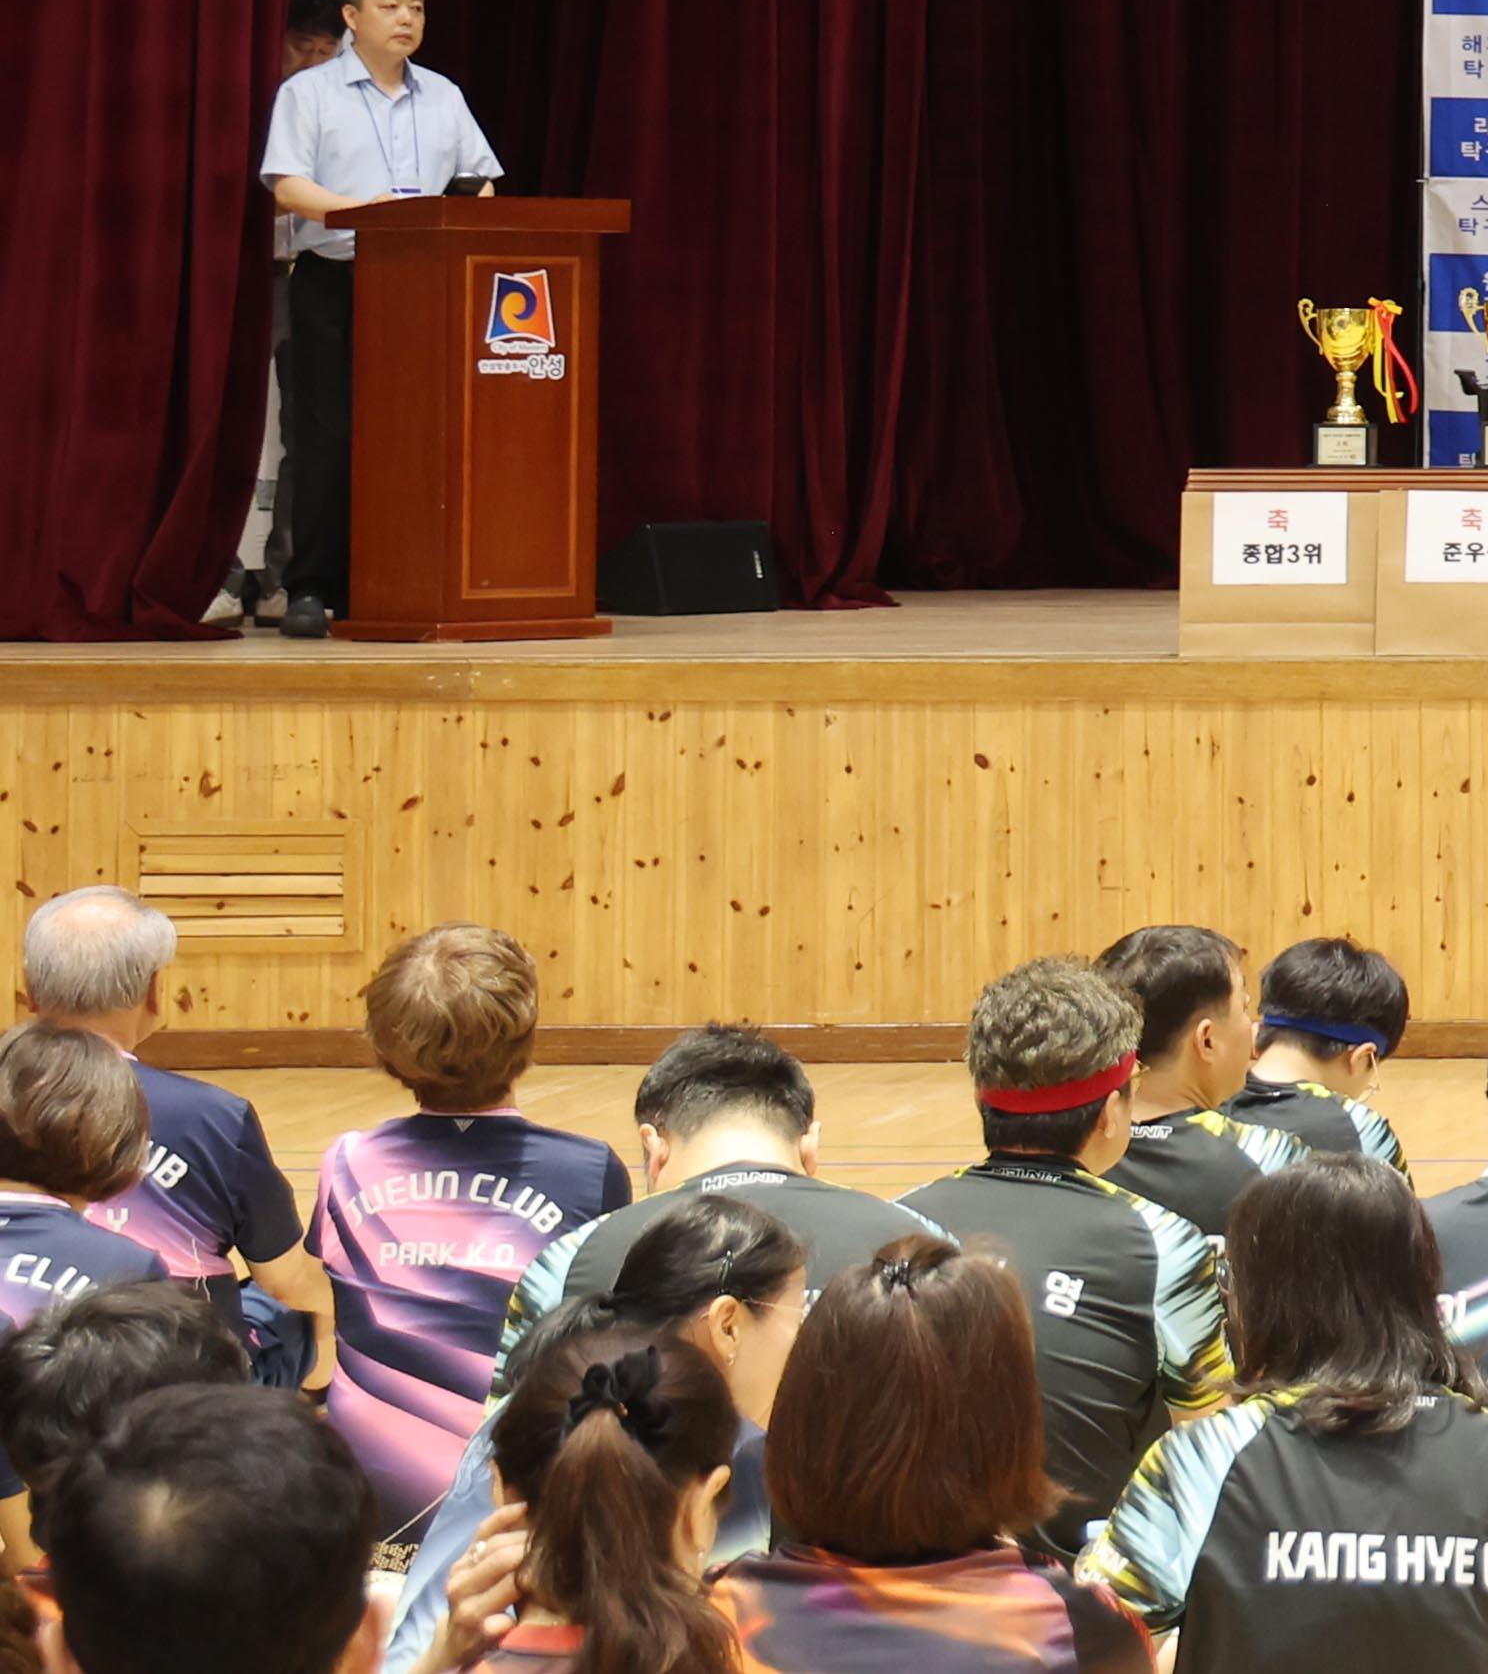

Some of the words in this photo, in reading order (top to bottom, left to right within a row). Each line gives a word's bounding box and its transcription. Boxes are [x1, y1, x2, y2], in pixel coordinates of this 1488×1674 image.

[528, 356, 562, 377] 안성
[1266, 507, 1290, 534] 축
[1460, 506, 1483, 533] 축
[1241, 541, 1323, 566] 종합3위
[346, 1169, 463, 1229] JUEUN
[468, 1171, 566, 1236] CLUB
[378, 1239, 456, 1267] PARK
[6, 1253, 92, 1301] CLU
[1266, 1530, 1384, 1583] KANG
[1396, 1533, 1477, 1587] HYE
